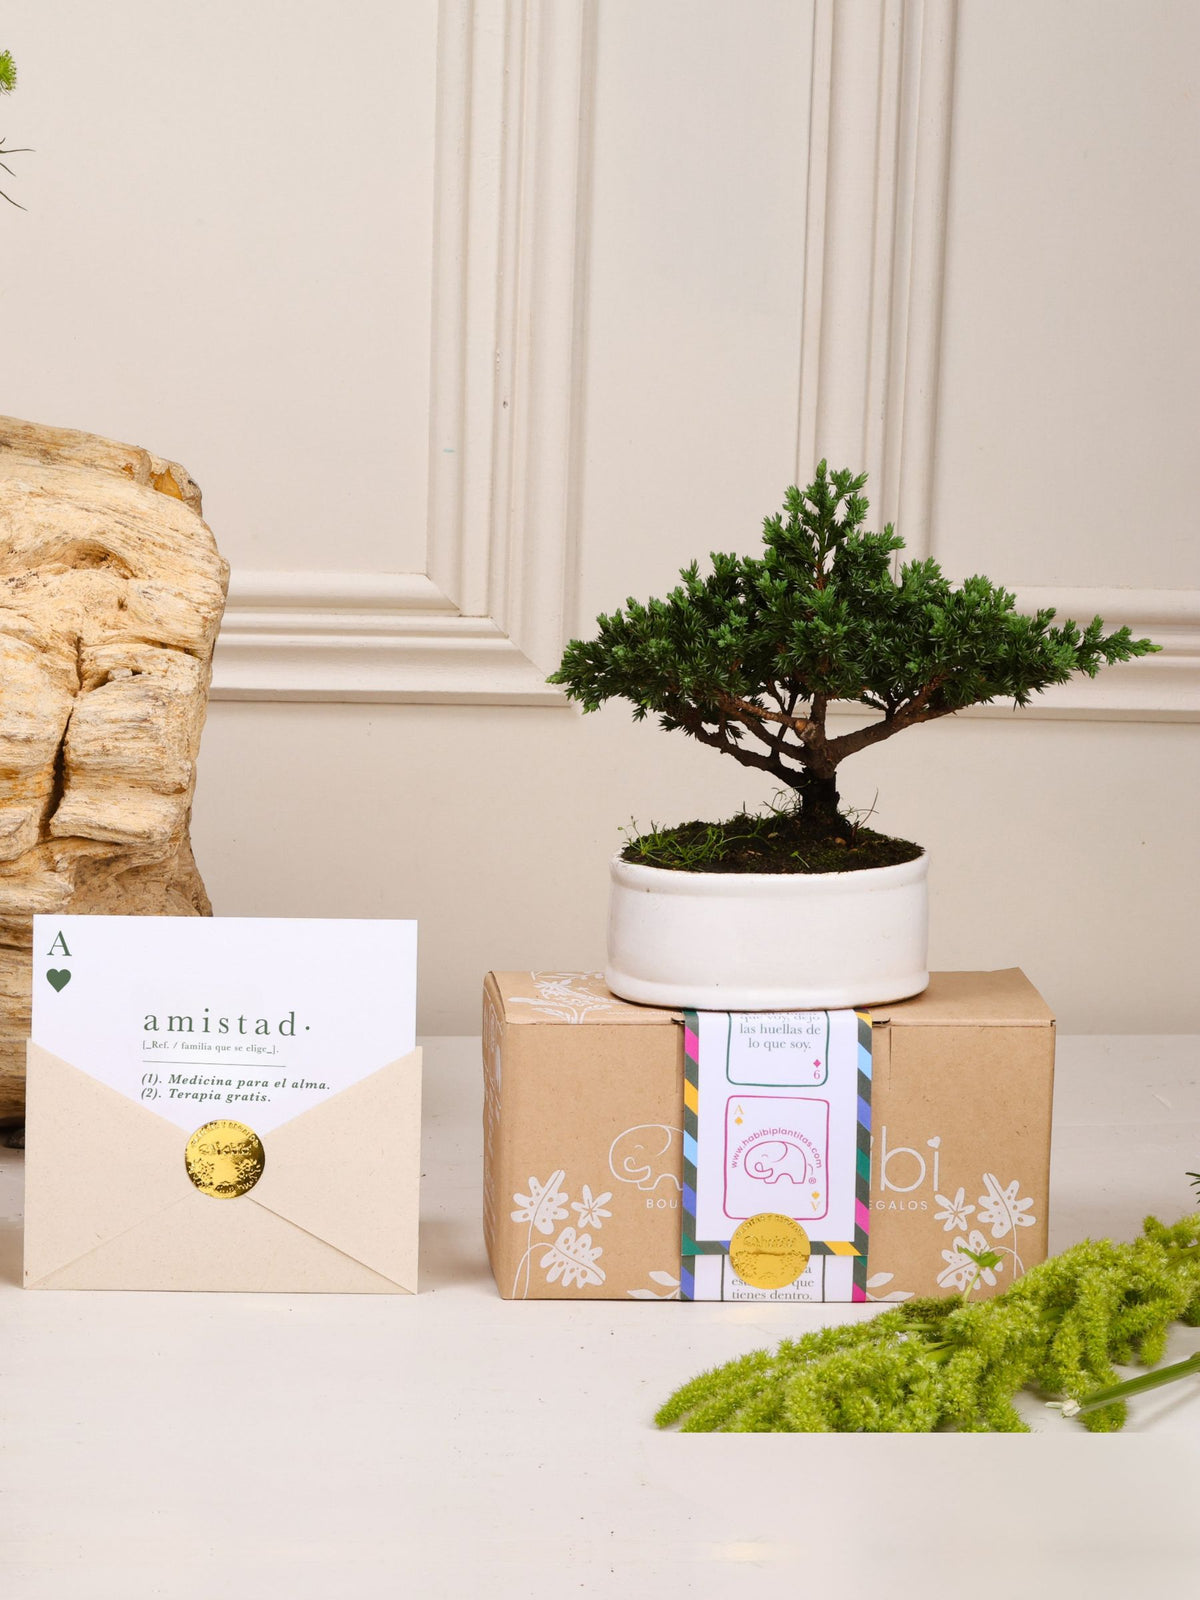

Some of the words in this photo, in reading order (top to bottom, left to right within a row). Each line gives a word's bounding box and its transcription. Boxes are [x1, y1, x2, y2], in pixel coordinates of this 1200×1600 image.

[46, 930, 73, 957] A
[739, 1023, 756, 1034] las
[760, 1023, 803, 1035] huellas
[806, 1023, 822, 1035] de
[181, 1040, 212, 1052] familia
[214, 1044, 232, 1055] que
[234, 1045, 243, 1053] se
[748, 1037, 760, 1048] lo
[763, 1040, 786, 1052] que
[790, 1040, 812, 1052] soy.
[140, 1072, 162, 1087] (1).
[168, 1073, 232, 1088] Medicina
[236, 1078, 270, 1091] para
[273, 1076, 287, 1089] el
[291, 1077, 332, 1091] alma.
[140, 1087, 162, 1101] (2).
[168, 1088, 222, 1103] Terapia
[225, 1090, 272, 1105] gratis.
[730, 1126, 823, 1169] www.habibiplantitas.com
[731, 1288, 767, 1300] tienes
[769, 1289, 813, 1301] dentro.
